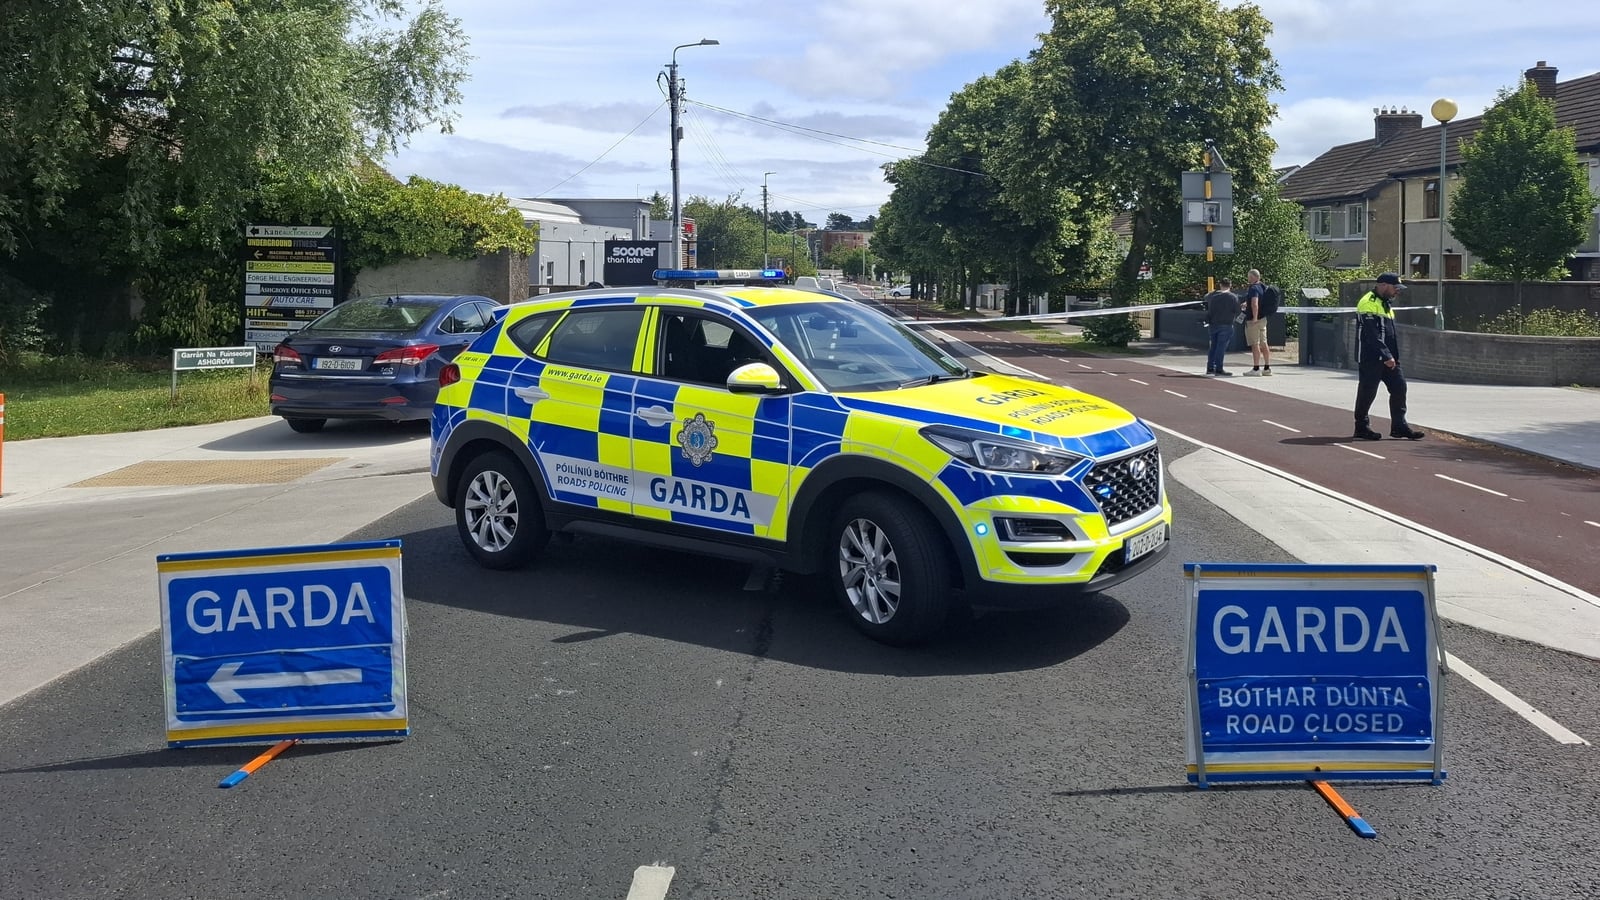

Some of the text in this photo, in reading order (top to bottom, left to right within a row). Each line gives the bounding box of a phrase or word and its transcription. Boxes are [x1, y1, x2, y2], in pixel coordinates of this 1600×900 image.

[248, 238, 292, 247] UNDERGROUND
[612, 246, 656, 257] sooner
[246, 308, 268, 316] HIIT
[322, 360, 356, 369] 192-D-6109
[547, 368, 602, 384] www.garda.ie
[556, 462, 629, 484] PÓILÍNIÚ BÓITHRE
[557, 475, 628, 496] ROADS POLICING
[650, 477, 750, 520] GARDA
[185, 581, 376, 635] GARDA
[1212, 604, 1410, 655] GARDA
[1218, 682, 1408, 708] BÓTHAR DÚNTA
[1226, 713, 1404, 734] ROAD CLOSED
